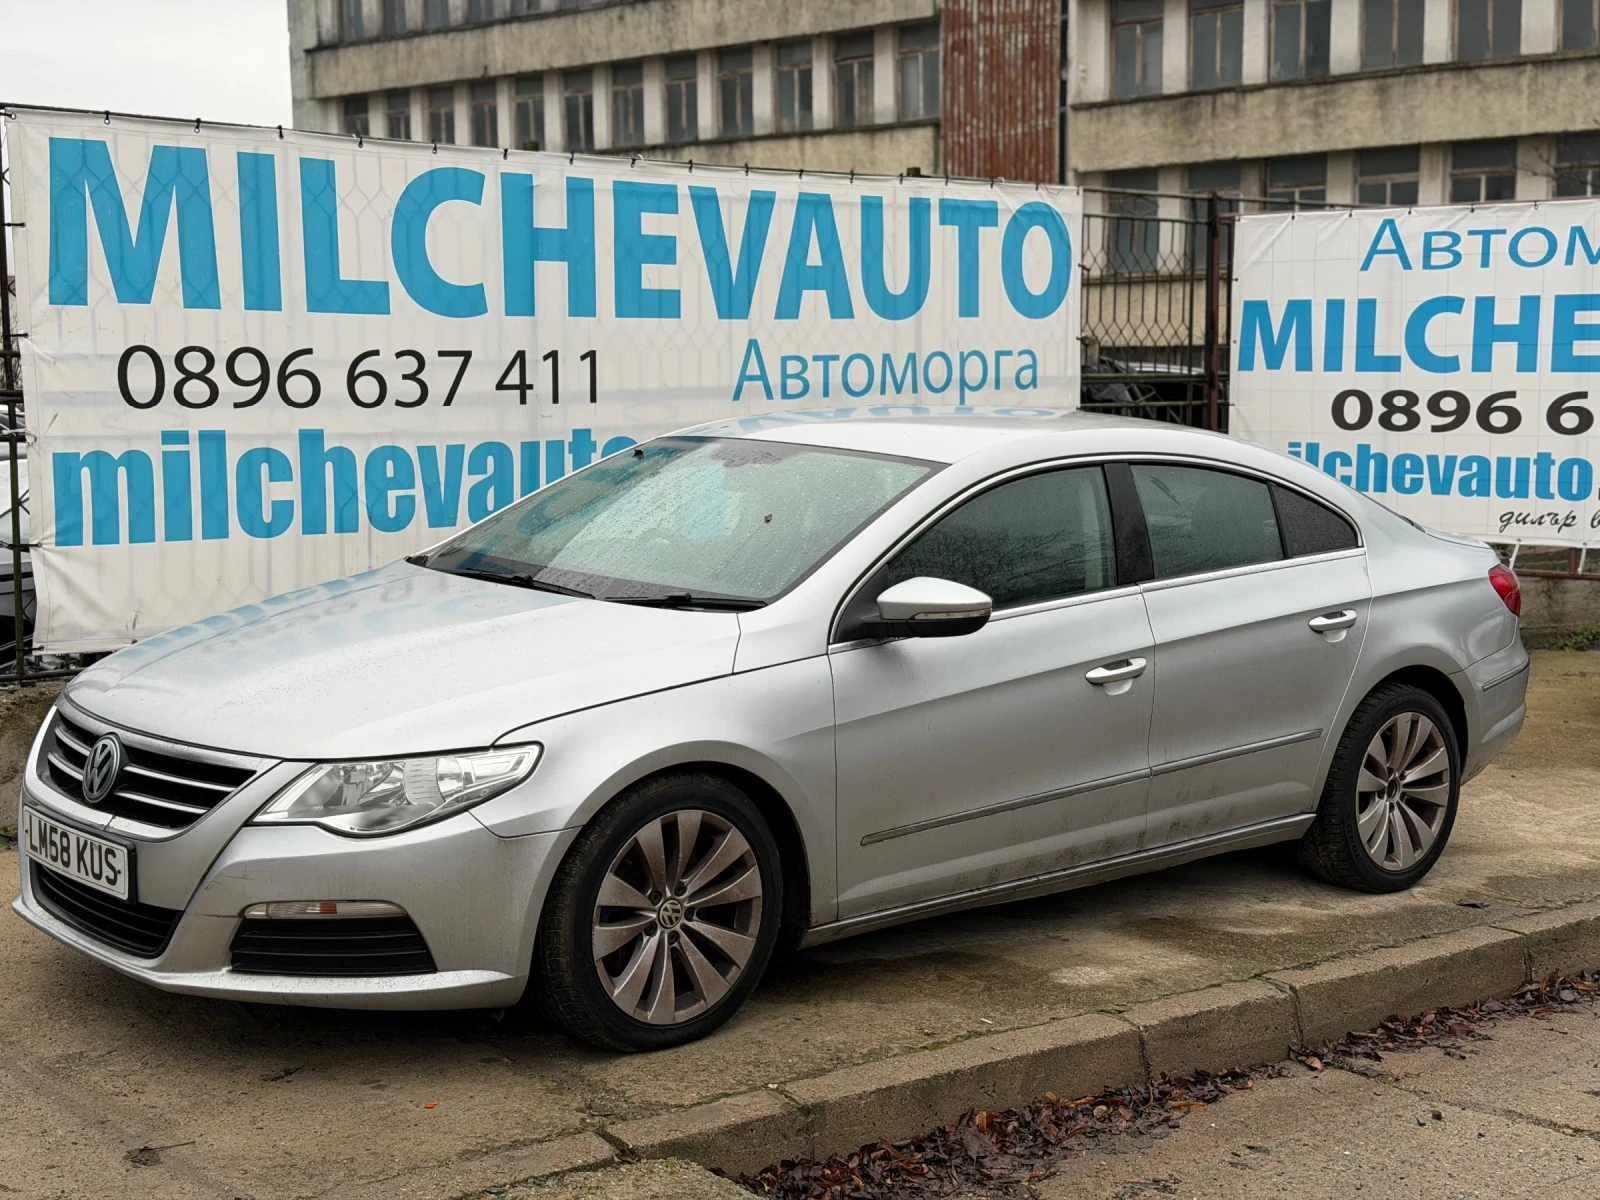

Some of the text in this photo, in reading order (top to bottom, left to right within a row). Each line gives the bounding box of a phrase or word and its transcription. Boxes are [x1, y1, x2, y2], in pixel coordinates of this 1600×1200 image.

[49, 137, 1072, 320] MILCHEVAUTO
[117, 345, 598, 409] 0896 637 411
[733, 338, 1037, 405] Автоморга
[1331, 388, 1522, 435] 0896
[52, 428, 638, 547] milchevaut
[1499, 510, 1577, 534] дилър
[29, 815, 119, 886] LM58 KUS
